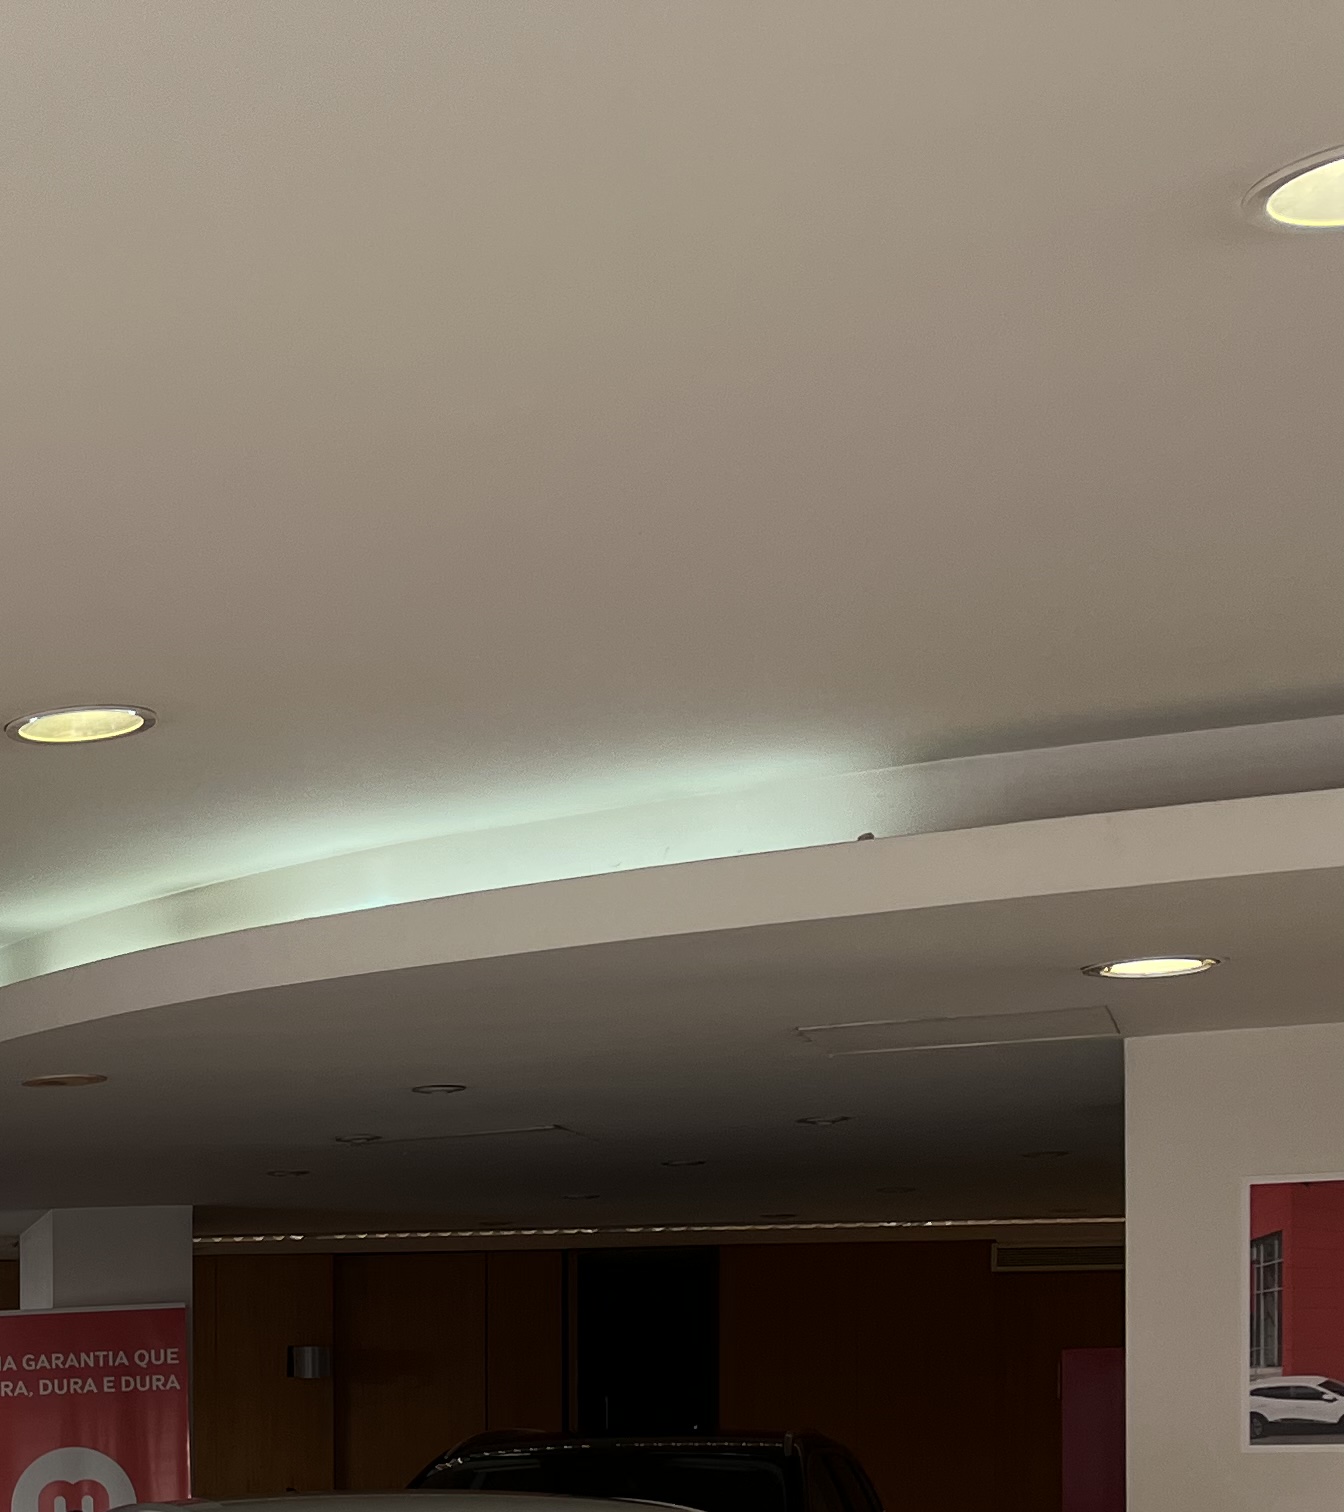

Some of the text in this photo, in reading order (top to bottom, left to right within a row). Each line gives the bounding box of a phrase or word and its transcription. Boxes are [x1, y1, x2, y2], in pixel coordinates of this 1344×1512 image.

[22, 1350, 129, 1370] GARANTIA
[134, 1348, 180, 1368] QUE
[39, 1378, 97, 1395] DURA
[103, 1376, 115, 1392] E
[121, 1375, 181, 1392] DURA
